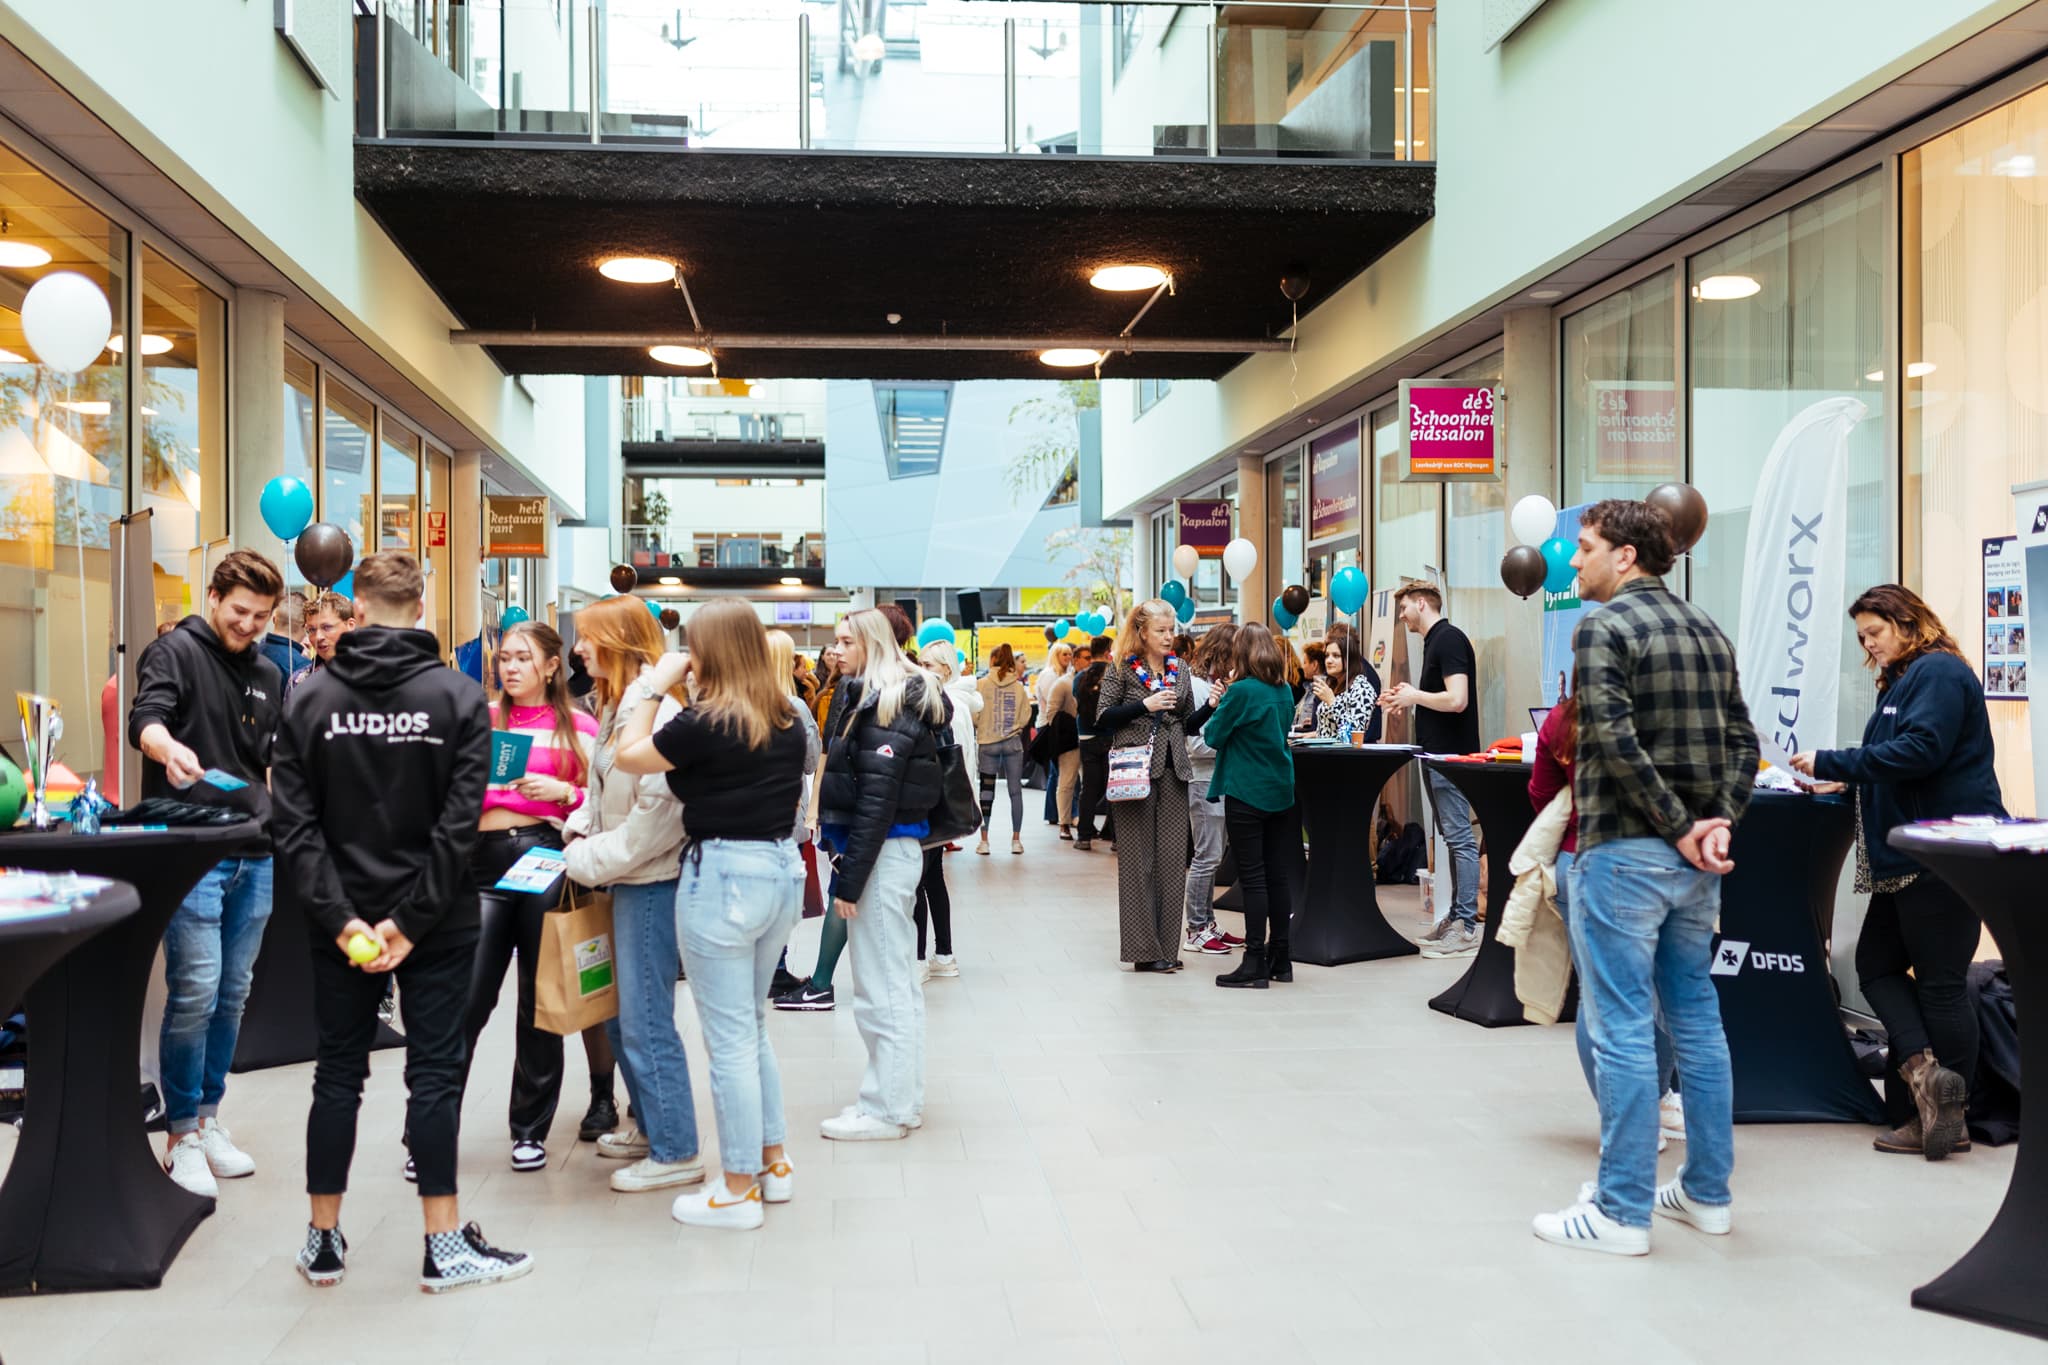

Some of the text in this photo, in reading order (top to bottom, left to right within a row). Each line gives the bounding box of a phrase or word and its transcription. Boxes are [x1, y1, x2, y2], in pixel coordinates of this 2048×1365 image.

[1462, 393, 1483, 410] de
[1410, 426, 1485, 441] eidssalon
[519, 503, 536, 515] het
[1211, 506, 1224, 517] de
[490, 524, 514, 534] rant
[1751, 951, 1805, 973] DFDS
